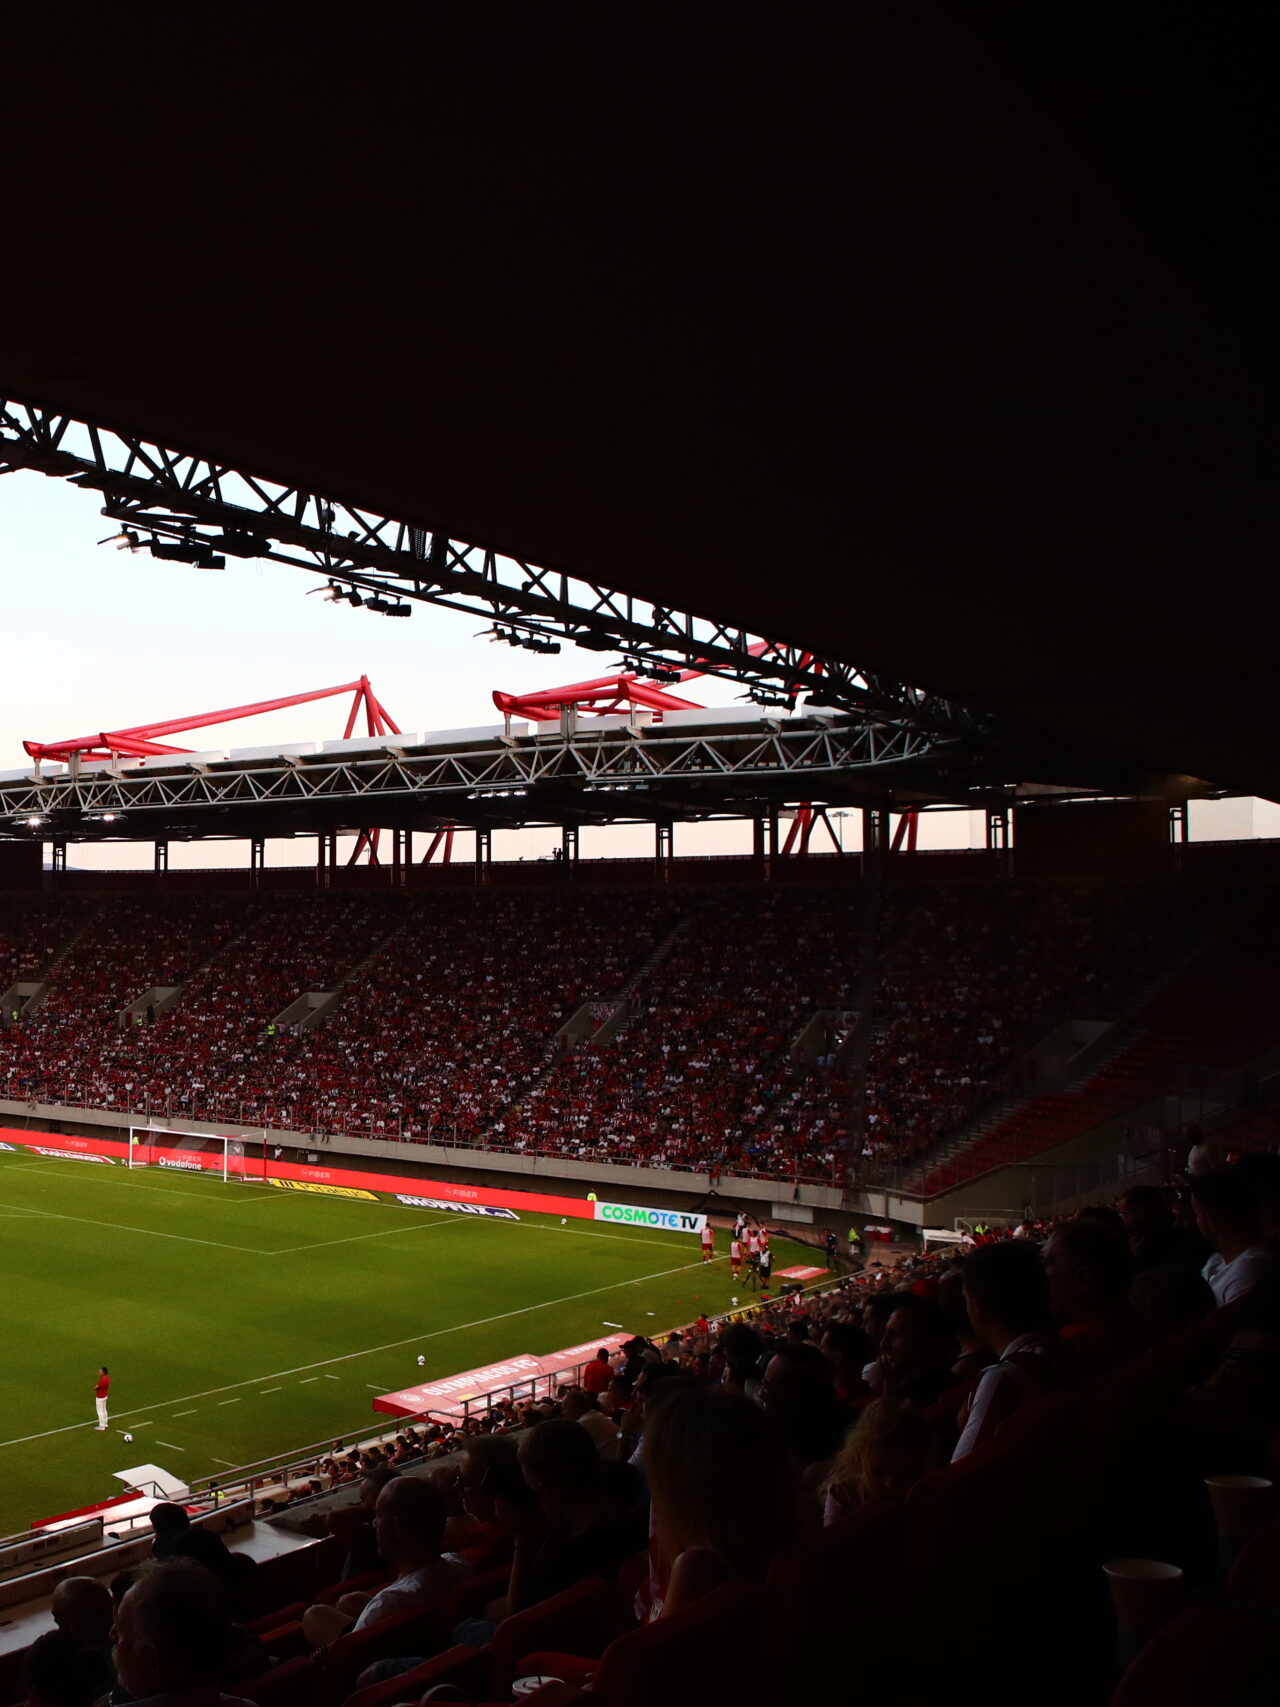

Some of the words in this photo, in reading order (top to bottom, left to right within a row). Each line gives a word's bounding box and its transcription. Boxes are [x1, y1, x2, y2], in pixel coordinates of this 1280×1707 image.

[167, 1158, 202, 1170] vodafone
[308, 1170, 331, 1179] FIBER
[452, 1189, 478, 1198] FIBER
[601, 1205, 678, 1227] COSMOTE
[679, 1215, 699, 1230] TV
[422, 1365, 519, 1396] OLYMPIACOS
[510, 1359, 539, 1370] FC
